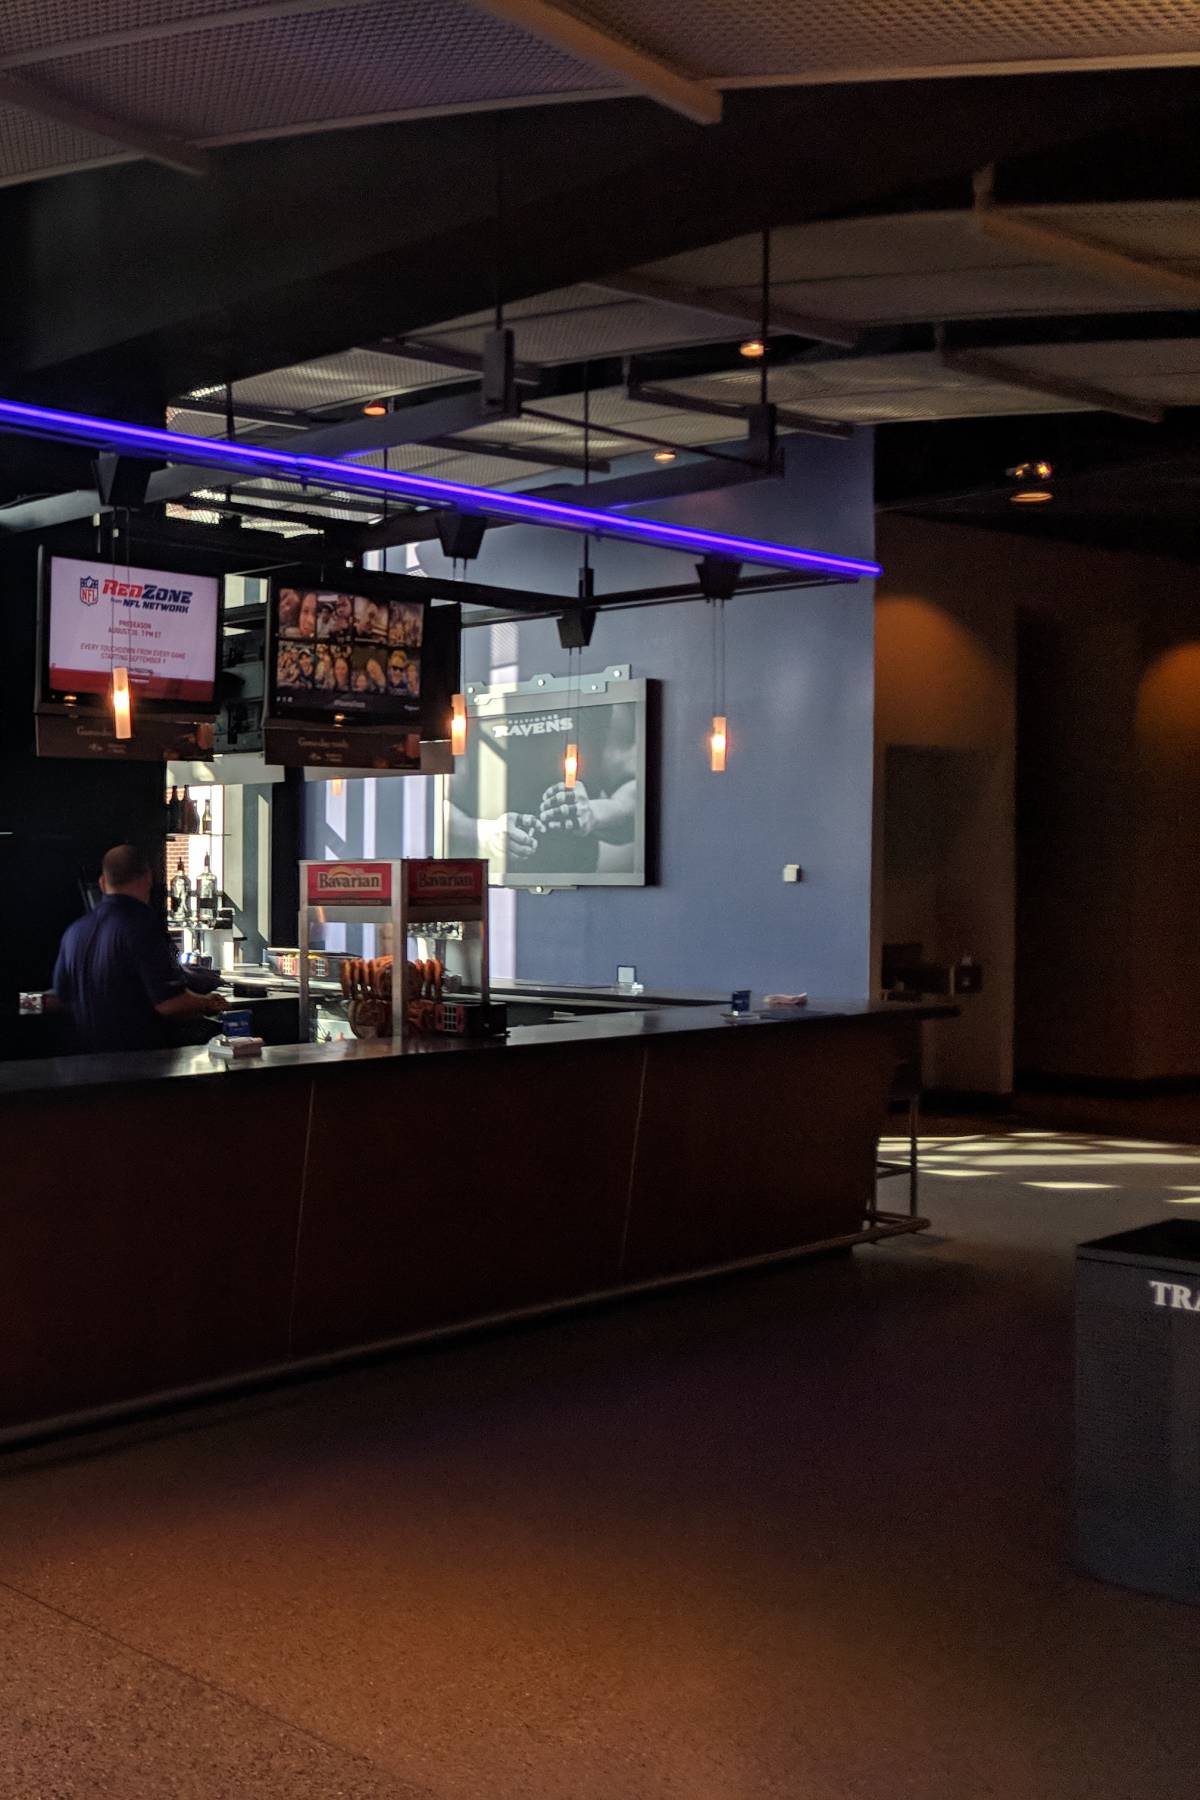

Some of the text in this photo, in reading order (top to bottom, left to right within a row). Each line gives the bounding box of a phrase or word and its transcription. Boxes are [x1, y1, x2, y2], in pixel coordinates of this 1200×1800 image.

[81, 588, 97, 603] NFL
[123, 599, 141, 609] NFL
[142, 601, 189, 614] NETWORK
[80, 642, 98, 651] EVERY
[136, 648, 152, 656] FROM
[153, 649, 170, 658] EVERY
[170, 652, 186, 660] GAME
[492, 717, 574, 738] RAVENS
[318, 872, 380, 889] Bavarian
